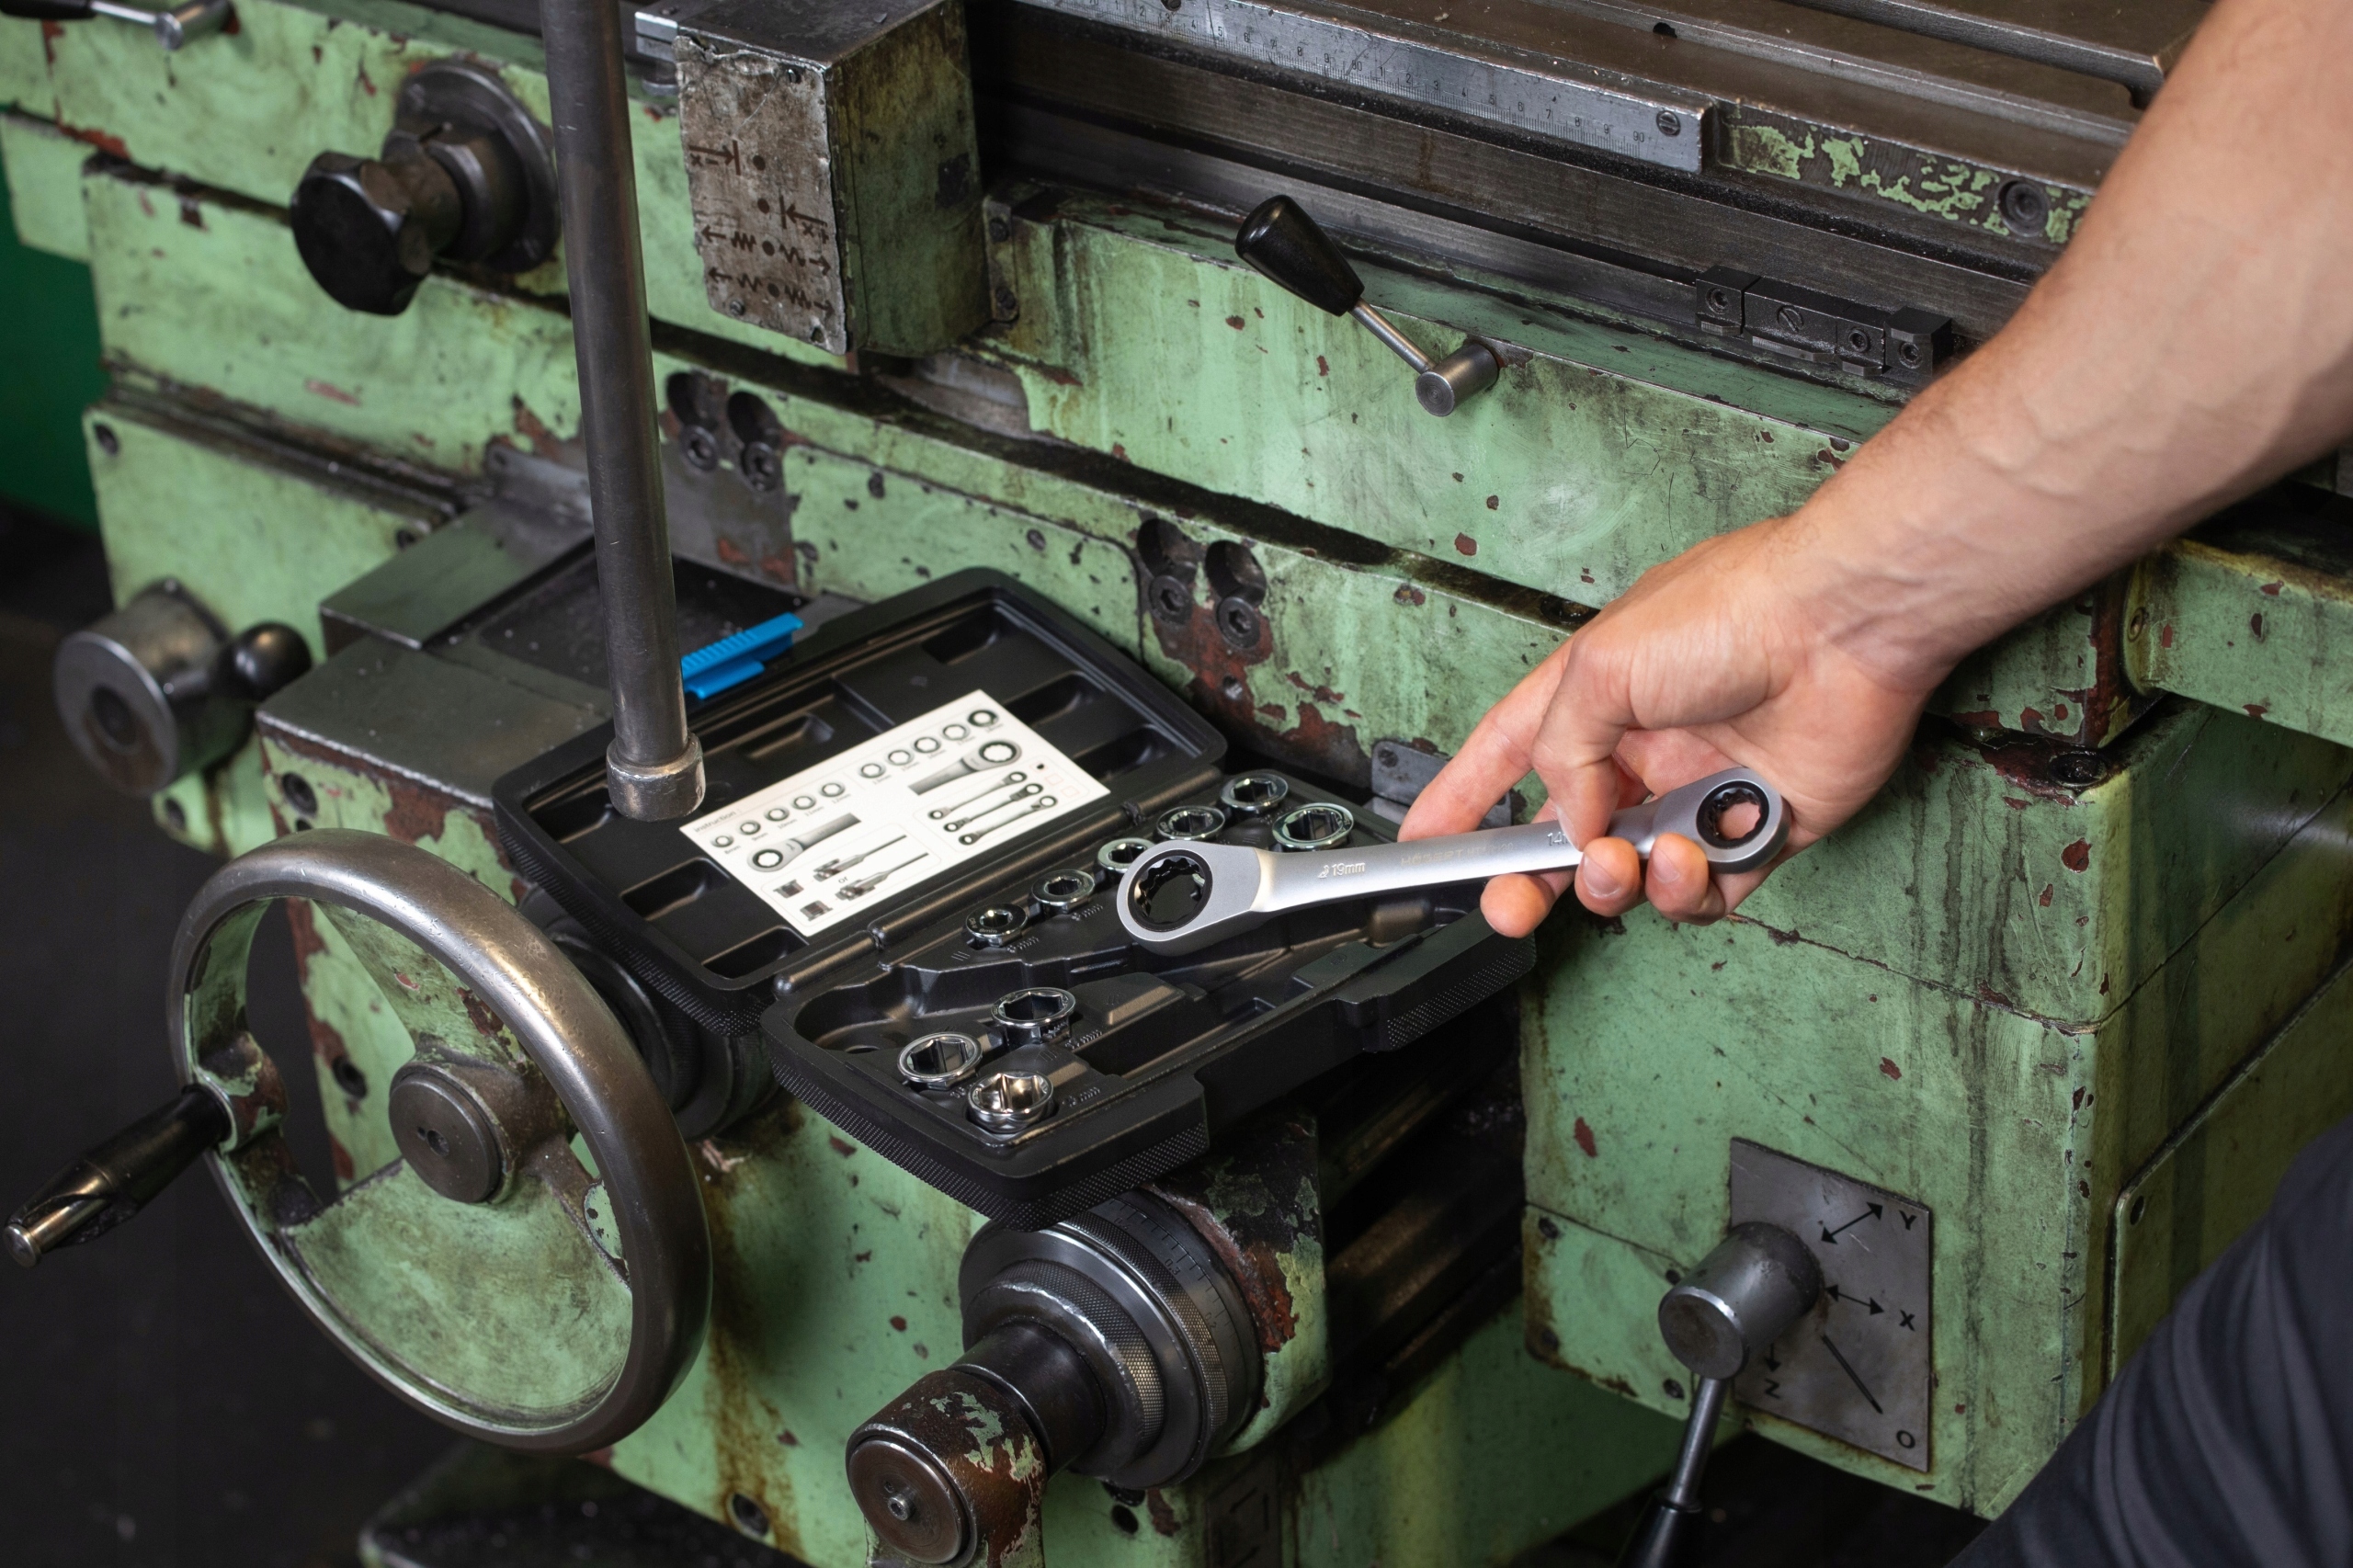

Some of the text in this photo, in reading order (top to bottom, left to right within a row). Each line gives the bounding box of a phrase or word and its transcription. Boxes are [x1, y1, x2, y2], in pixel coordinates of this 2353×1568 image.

[1632, 131, 1645, 143] 90
[1331, 861, 1366, 877] 19mm
[837, 874, 850, 886] or
[1897, 1209, 1918, 1231] Y
[1164, 1257, 1181, 1276] 0.3
[1898, 1309, 1916, 1333] X
[1764, 1378, 1781, 1400] Z
